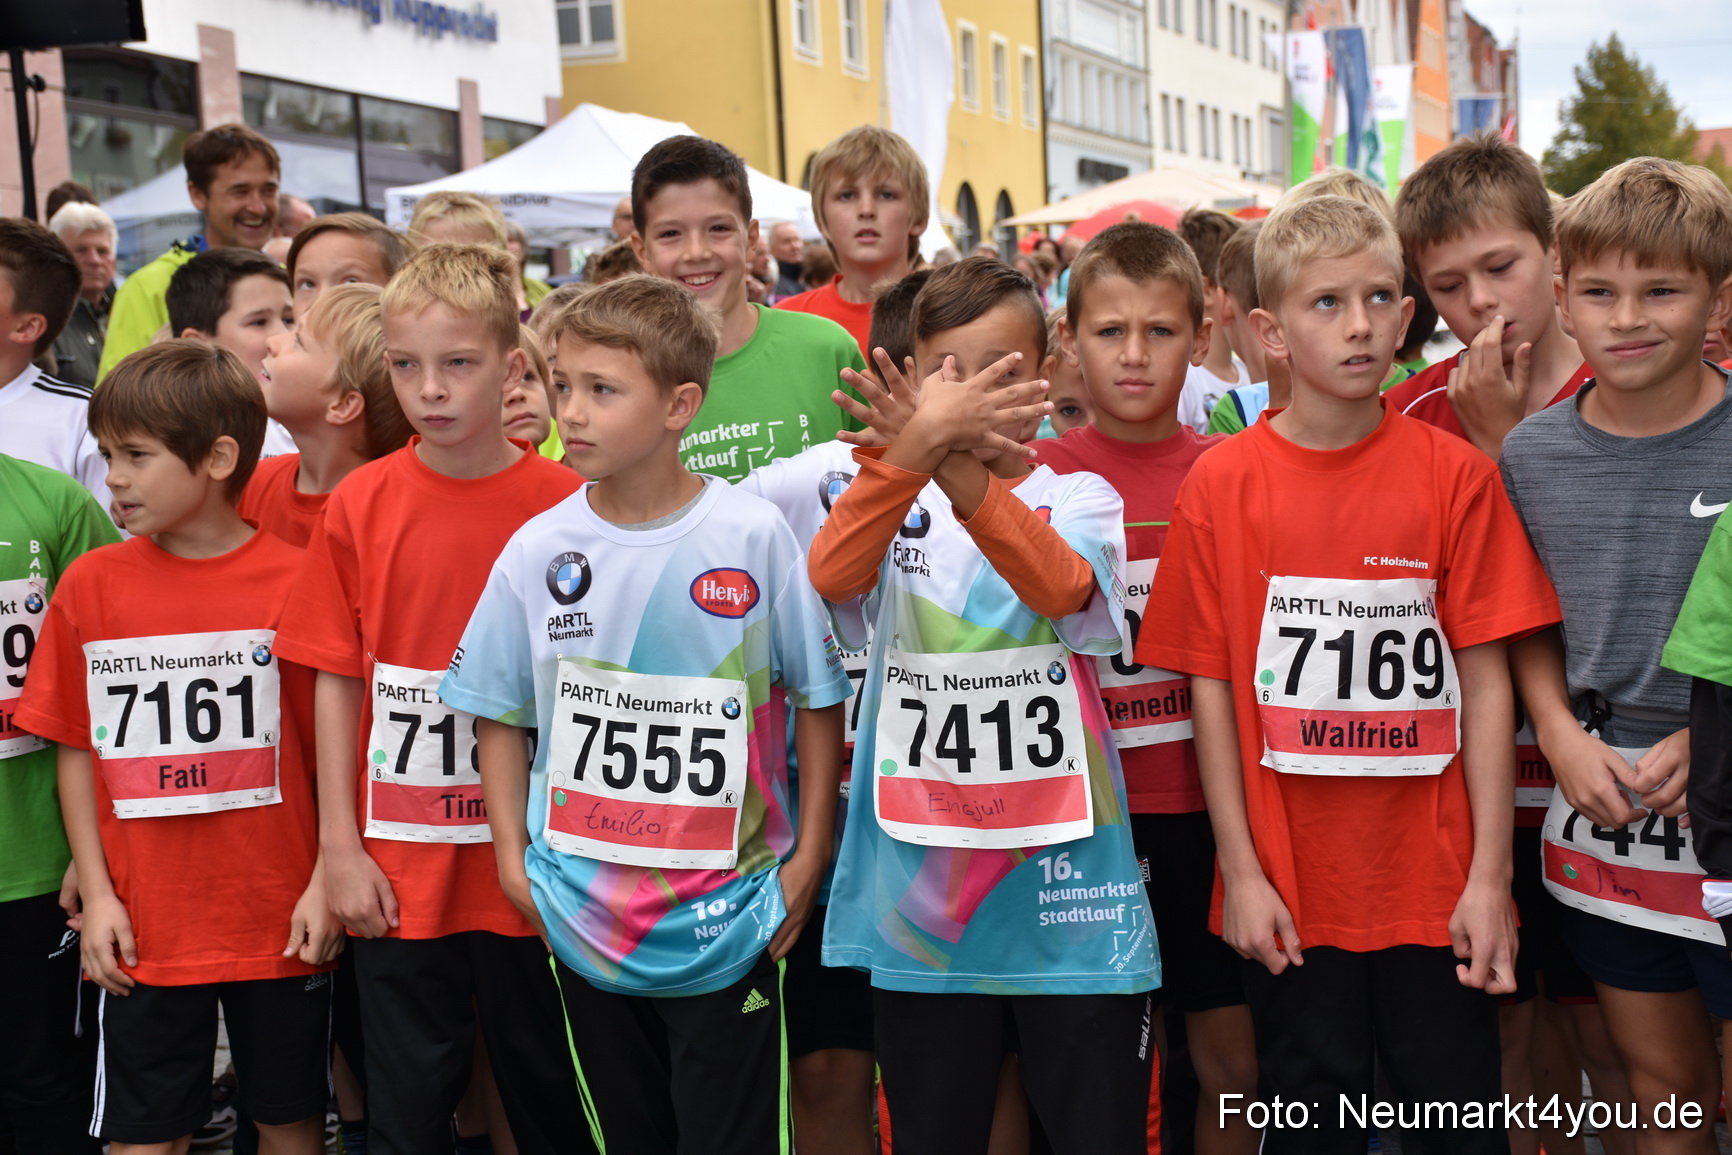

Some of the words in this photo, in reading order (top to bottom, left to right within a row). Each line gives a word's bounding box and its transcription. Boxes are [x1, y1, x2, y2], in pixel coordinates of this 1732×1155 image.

[1364, 556, 1378, 566] FC
[1380, 557, 1428, 569] Holzheim
[1270, 595, 1331, 616] PARTL
[1338, 600, 1428, 618] Neumarkt
[547, 612, 593, 631] PARTL
[548, 627, 594, 642] Neumarkt
[91, 656, 147, 675] PARTL
[151, 650, 244, 671] Neumarkt
[1278, 626, 1444, 700] 7169
[887, 666, 937, 692] PARTL
[944, 668, 1041, 691] Neumarkt
[378, 682, 432, 704] PARTL
[561, 682, 612, 708] PARTL
[617, 692, 713, 715] Neumarkt
[1262, 690, 1269, 702] 6
[1444, 692, 1452, 704] K
[107, 675, 255, 748] 7161
[264, 732, 272, 744] K
[900, 695, 1064, 773] 7413
[1301, 718, 1418, 748] Walfried
[572, 712, 727, 797] 7555
[1067, 759, 1076, 771] K
[159, 763, 207, 789] Fati
[375, 768, 382, 779] 6
[724, 792, 732, 804] K
[1038, 852, 1082, 884] 16.
[1038, 881, 1138, 905] Neumarkter
[1039, 904, 1125, 926] Stadtlauf
[741, 998, 770, 1014] adidas
